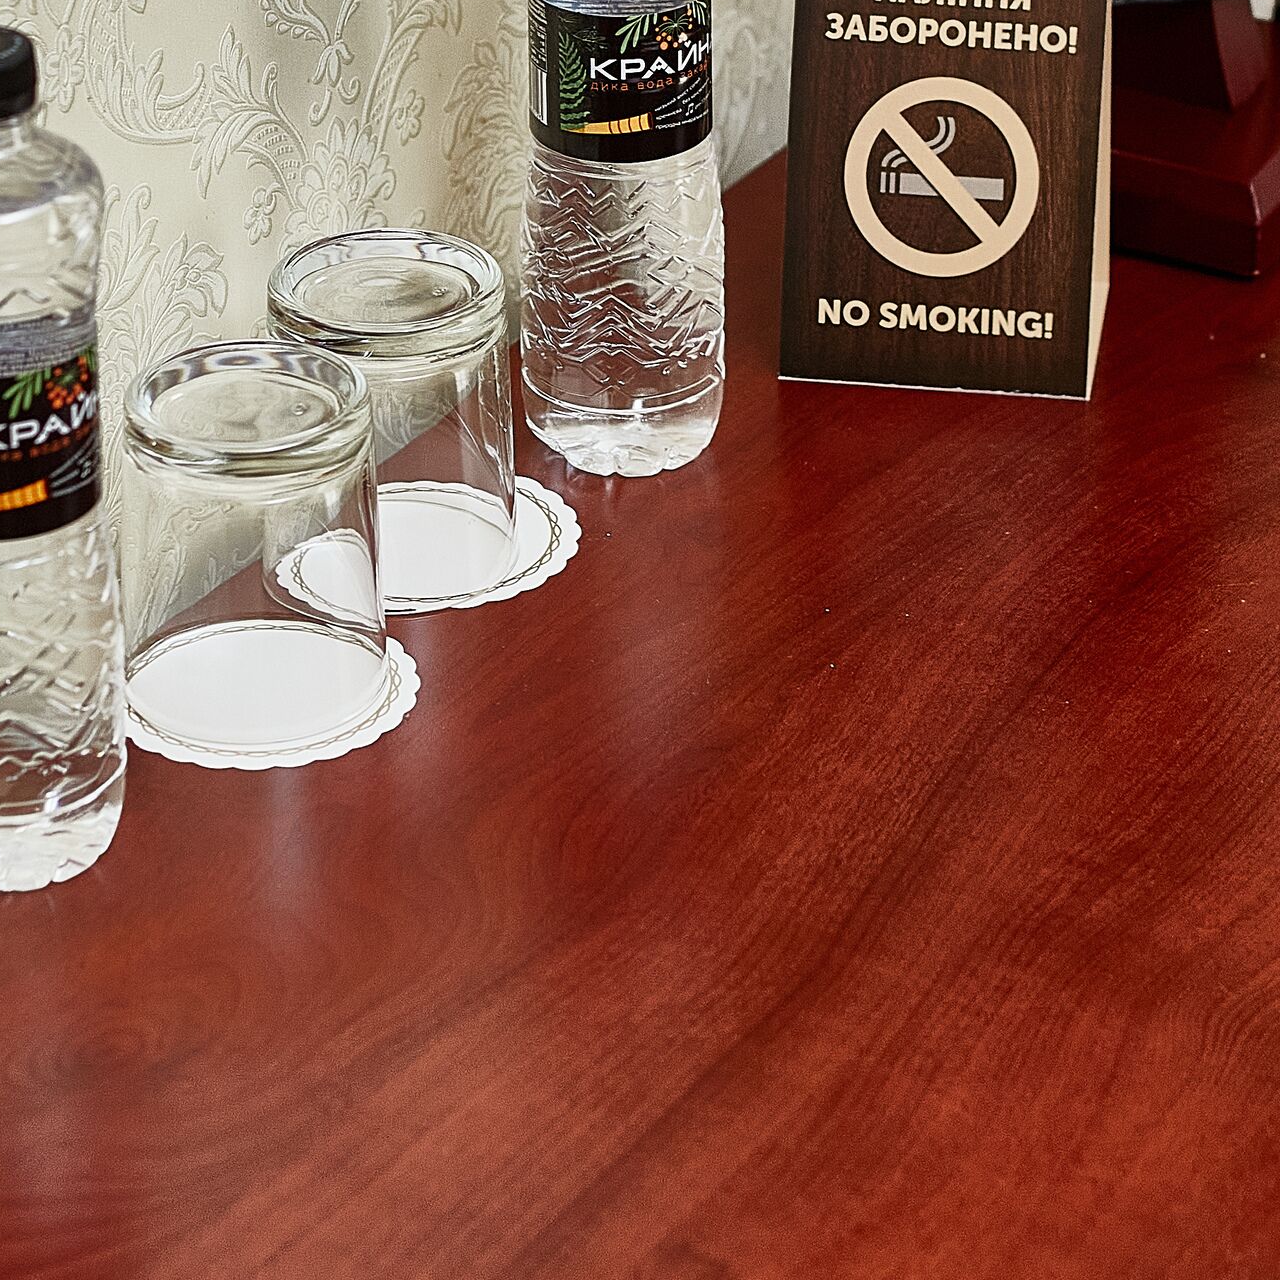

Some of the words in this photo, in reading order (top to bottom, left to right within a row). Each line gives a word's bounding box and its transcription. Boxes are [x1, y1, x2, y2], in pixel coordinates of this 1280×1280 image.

[824, 13, 1078, 54] ЗАБОРОНЕНО!
[590, 33, 711, 81] КРАЙН
[818, 298, 870, 327] NO
[878, 303, 1053, 340] SMOKING!
